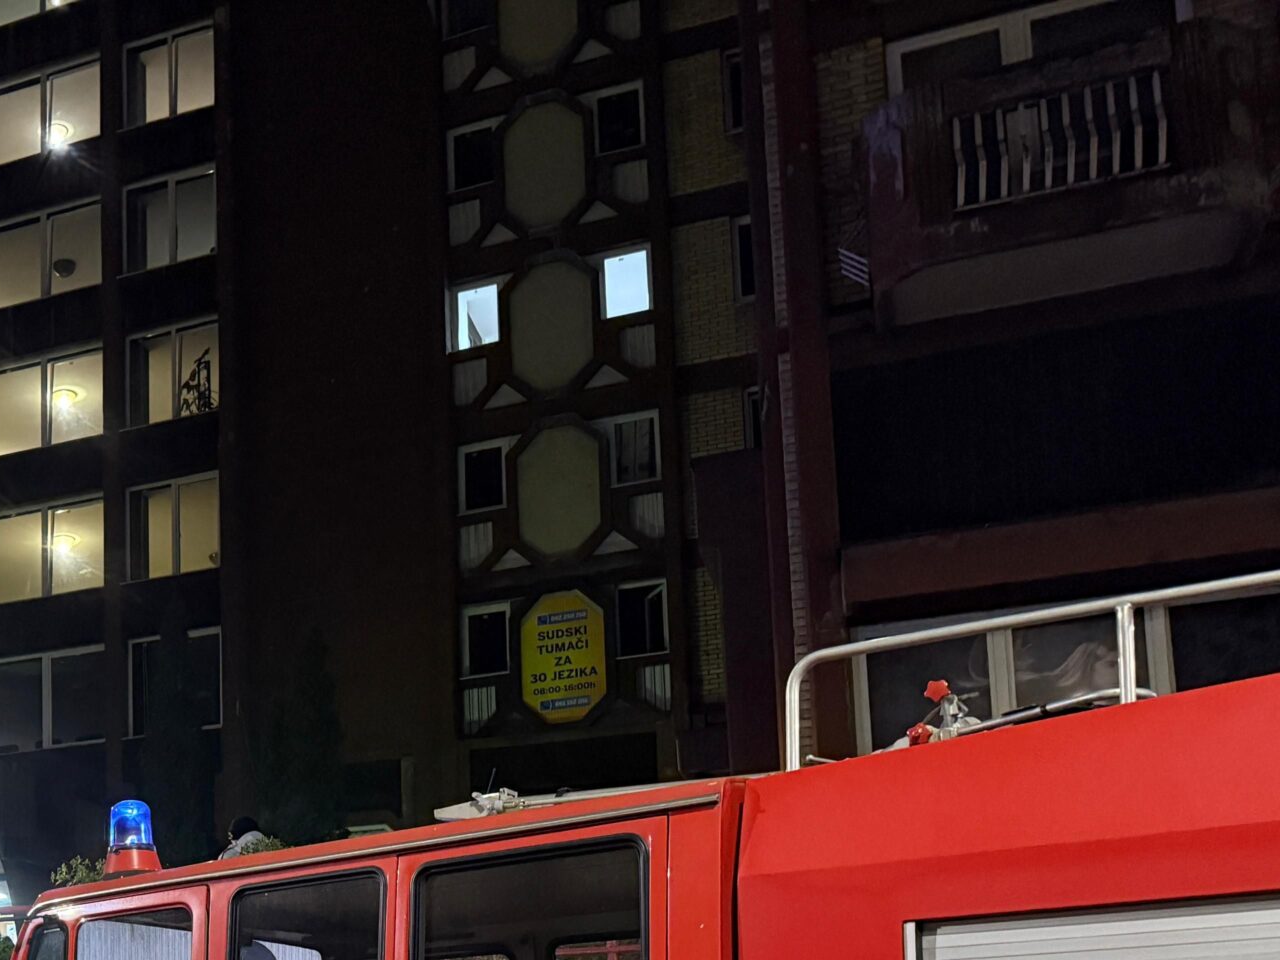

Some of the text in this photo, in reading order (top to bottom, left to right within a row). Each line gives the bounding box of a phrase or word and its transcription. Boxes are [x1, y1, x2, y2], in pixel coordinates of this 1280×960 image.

[537, 625, 588, 641] SUDSKI
[537, 637, 589, 655] TUMAČI
[554, 656, 572, 667] ZA
[530, 666, 598, 684] 30 JEZIKA
